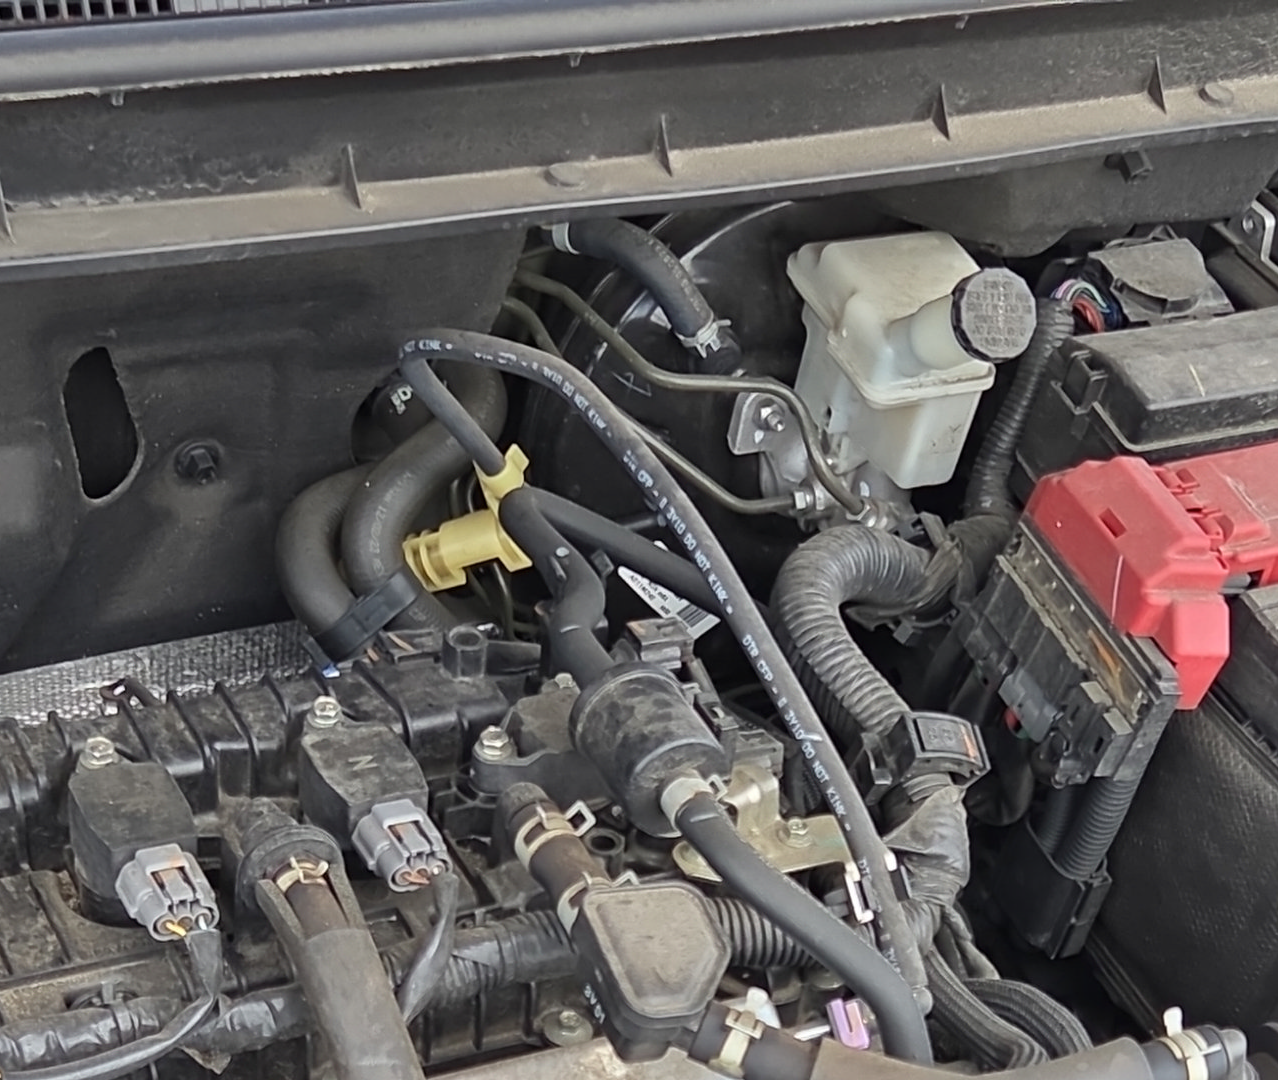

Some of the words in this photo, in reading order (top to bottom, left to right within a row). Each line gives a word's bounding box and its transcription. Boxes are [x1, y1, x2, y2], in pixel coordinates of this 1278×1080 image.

[683, 533, 697, 551] DO
[694, 549, 711, 573] NOT
[708, 572, 729, 604] KINK
[784, 709, 804, 740] 3Y10
[802, 741, 816, 759] DO
[812, 761, 830, 784] NOT
[826, 786, 847, 818] KINK
